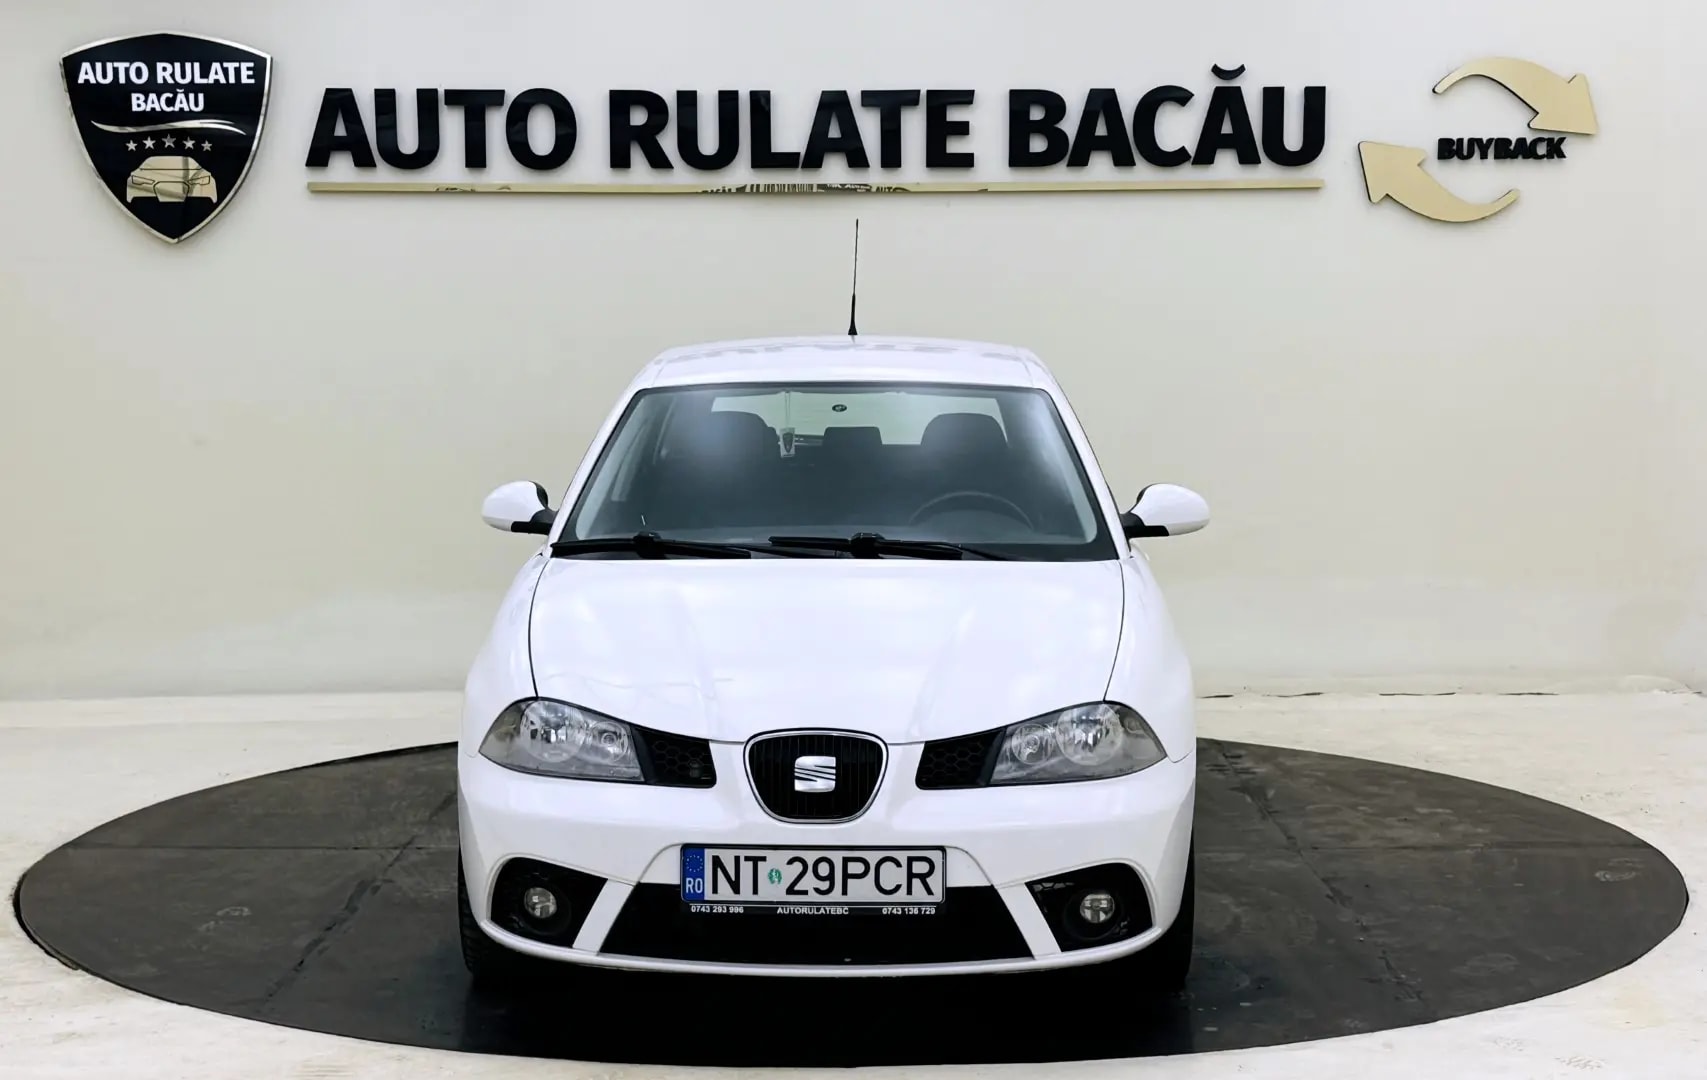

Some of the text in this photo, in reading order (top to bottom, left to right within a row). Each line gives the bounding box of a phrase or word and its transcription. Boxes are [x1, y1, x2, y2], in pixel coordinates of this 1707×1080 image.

[77, 61, 256, 84] AUTO RULATE
[130, 88, 205, 112] BACĂU
[305, 63, 1327, 171] AUTO RULATE BACĂU
[1437, 136, 1567, 161] BUYBACK
[685, 877, 704, 894] RO
[711, 855, 936, 897] NT 29PCR
[690, 905, 711, 913] 0743
[712, 905, 728, 913] 293
[776, 907, 849, 915] AUTORULATEBC
[881, 907, 902, 915] 0743
[920, 907, 936, 915] 729
